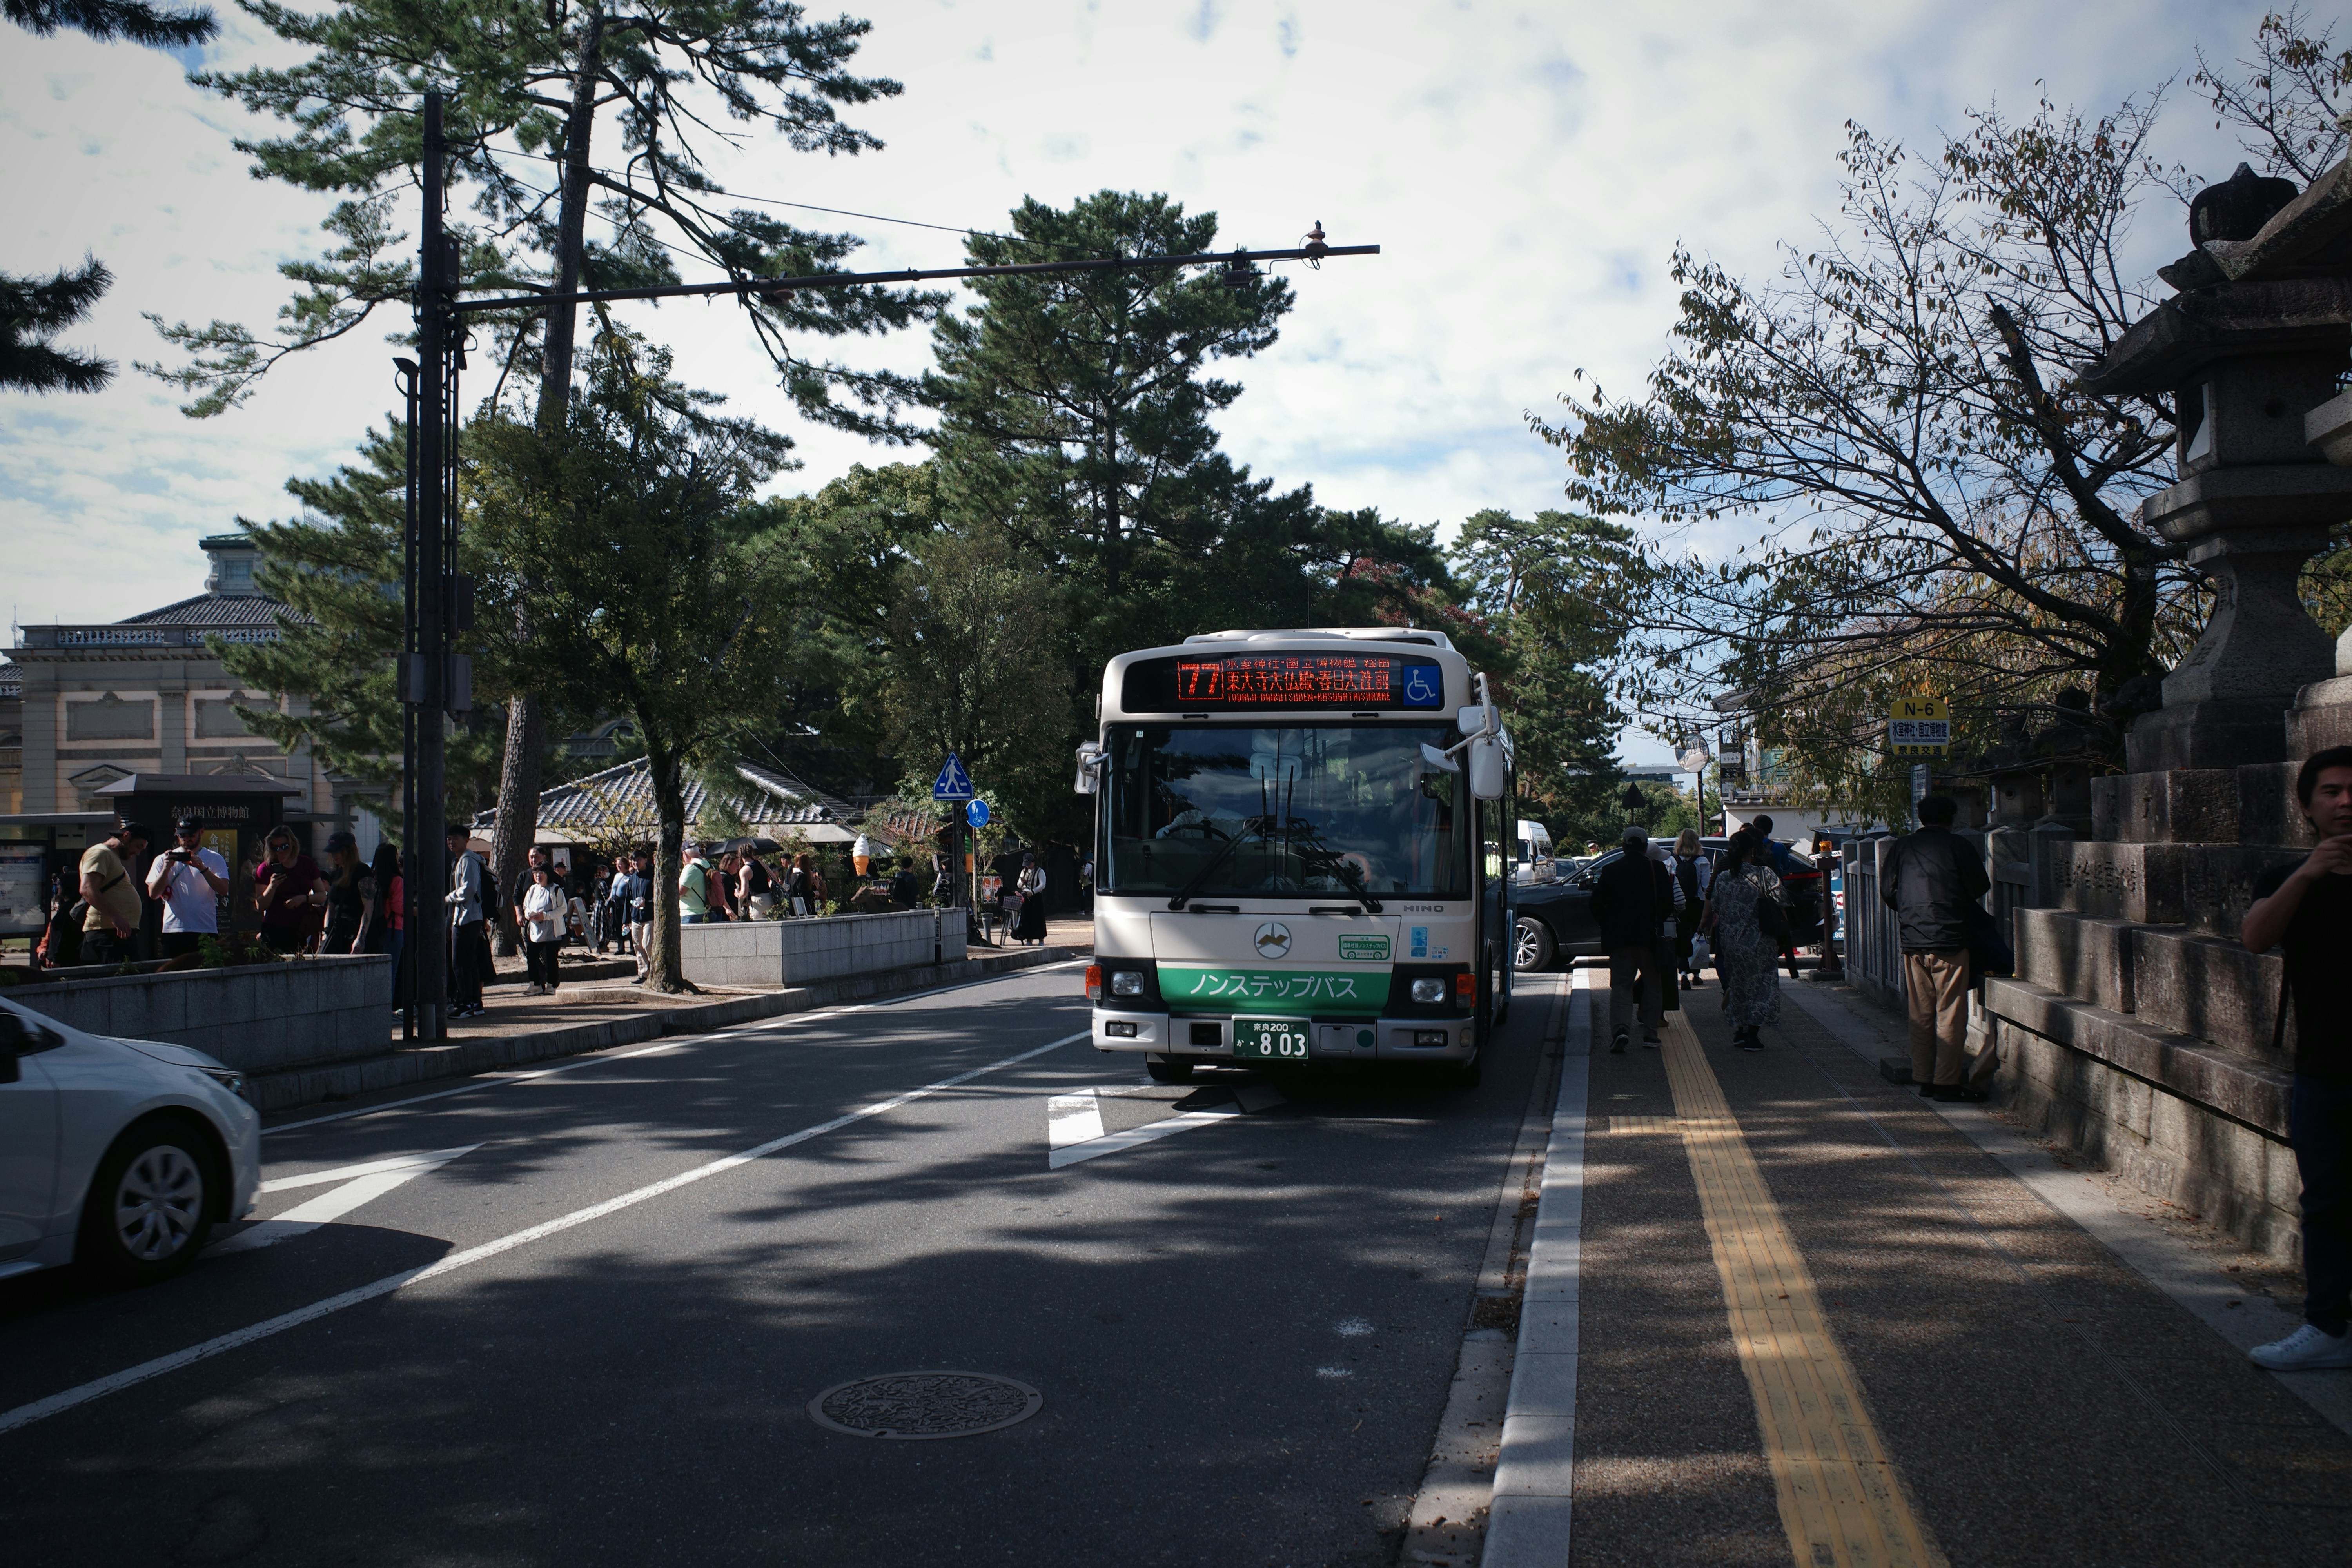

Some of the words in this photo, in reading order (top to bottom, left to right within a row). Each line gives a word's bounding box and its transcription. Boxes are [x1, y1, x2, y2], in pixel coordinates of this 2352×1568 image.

[1364, 659, 1390, 668] 経由
[1181, 663, 1220, 695] 77
[1226, 670, 1390, 691] 東大寺大仏殿・春日大社前
[1905, 703, 1934, 716] N-6
[1892, 722, 1947, 737] 氷室神社・国立博物館
[1898, 746, 1942, 755] 奈良交通
[1190, 974, 1357, 998] ノンステップバス
[1236, 1039, 1245, 1047] か
